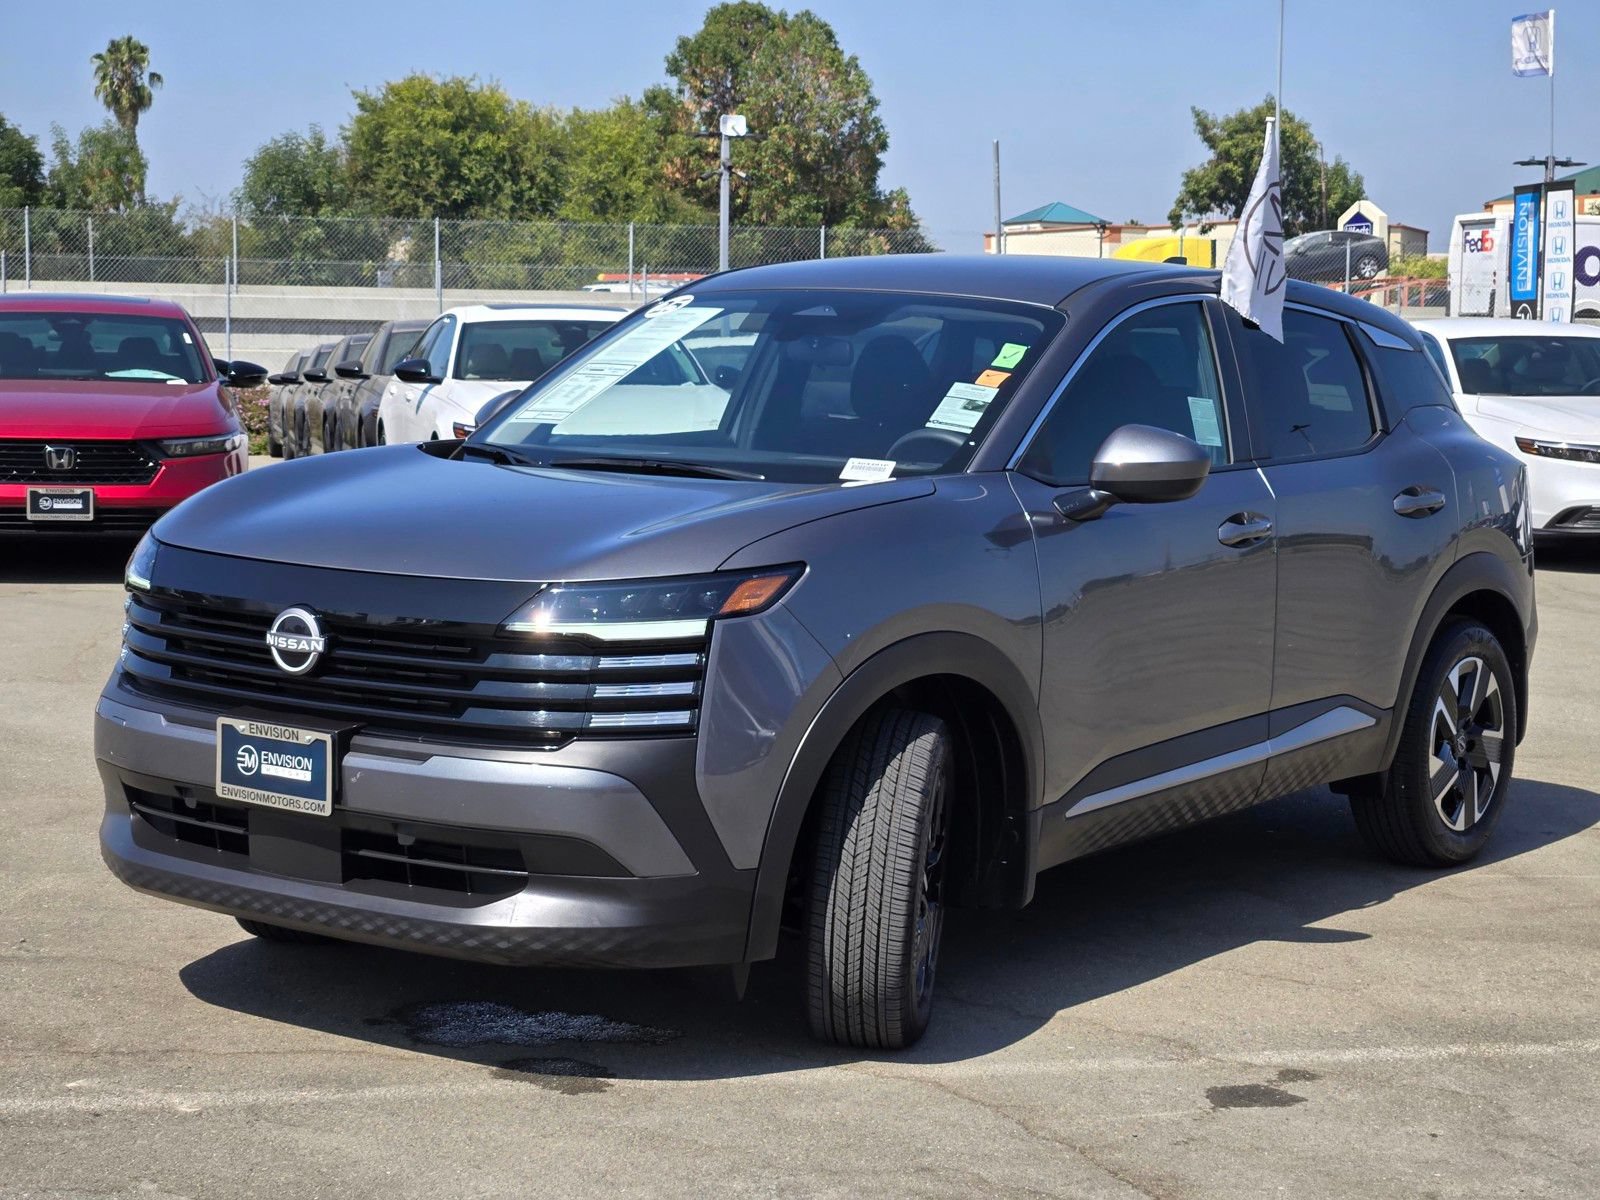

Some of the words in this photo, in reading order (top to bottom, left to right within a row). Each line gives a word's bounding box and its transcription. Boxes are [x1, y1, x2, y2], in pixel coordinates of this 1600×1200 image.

[1516, 202, 1529, 292] ENVISION
[266, 632, 325, 651] NISSAN
[248, 723, 299, 742] ENVISION
[261, 750, 313, 771] ENVISION
[221, 785, 326, 814] ENVISIONMOTORS.COM
